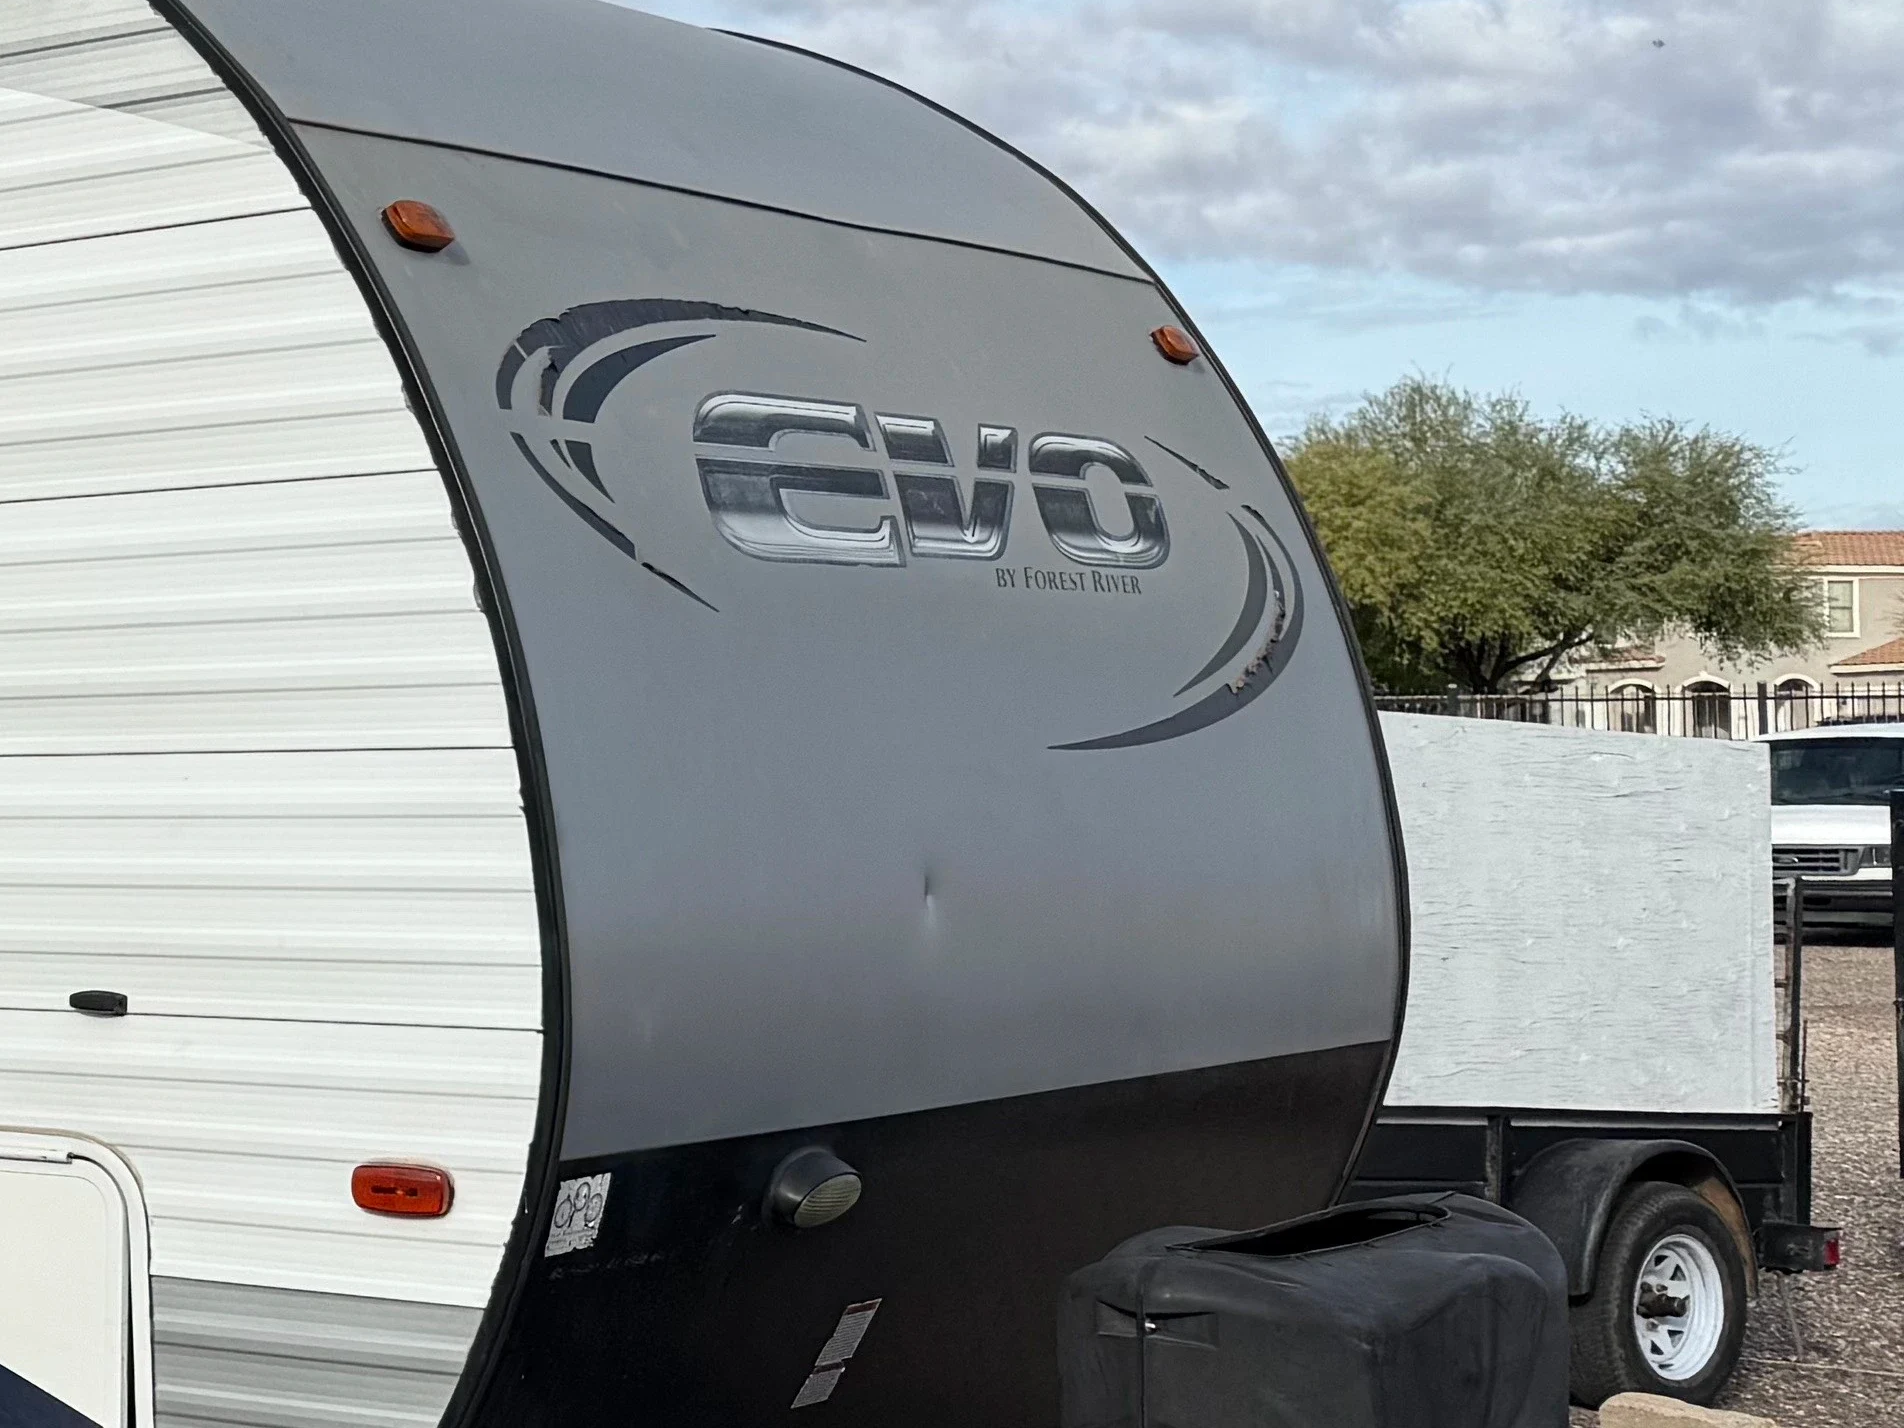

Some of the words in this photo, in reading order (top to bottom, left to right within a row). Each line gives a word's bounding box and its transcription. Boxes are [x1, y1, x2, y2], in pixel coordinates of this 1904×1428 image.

[693, 390, 1171, 568] EVO
[995, 567, 1016, 588] BY
[1024, 566, 1085, 592] FOREST
[1091, 570, 1142, 595] RIVER
